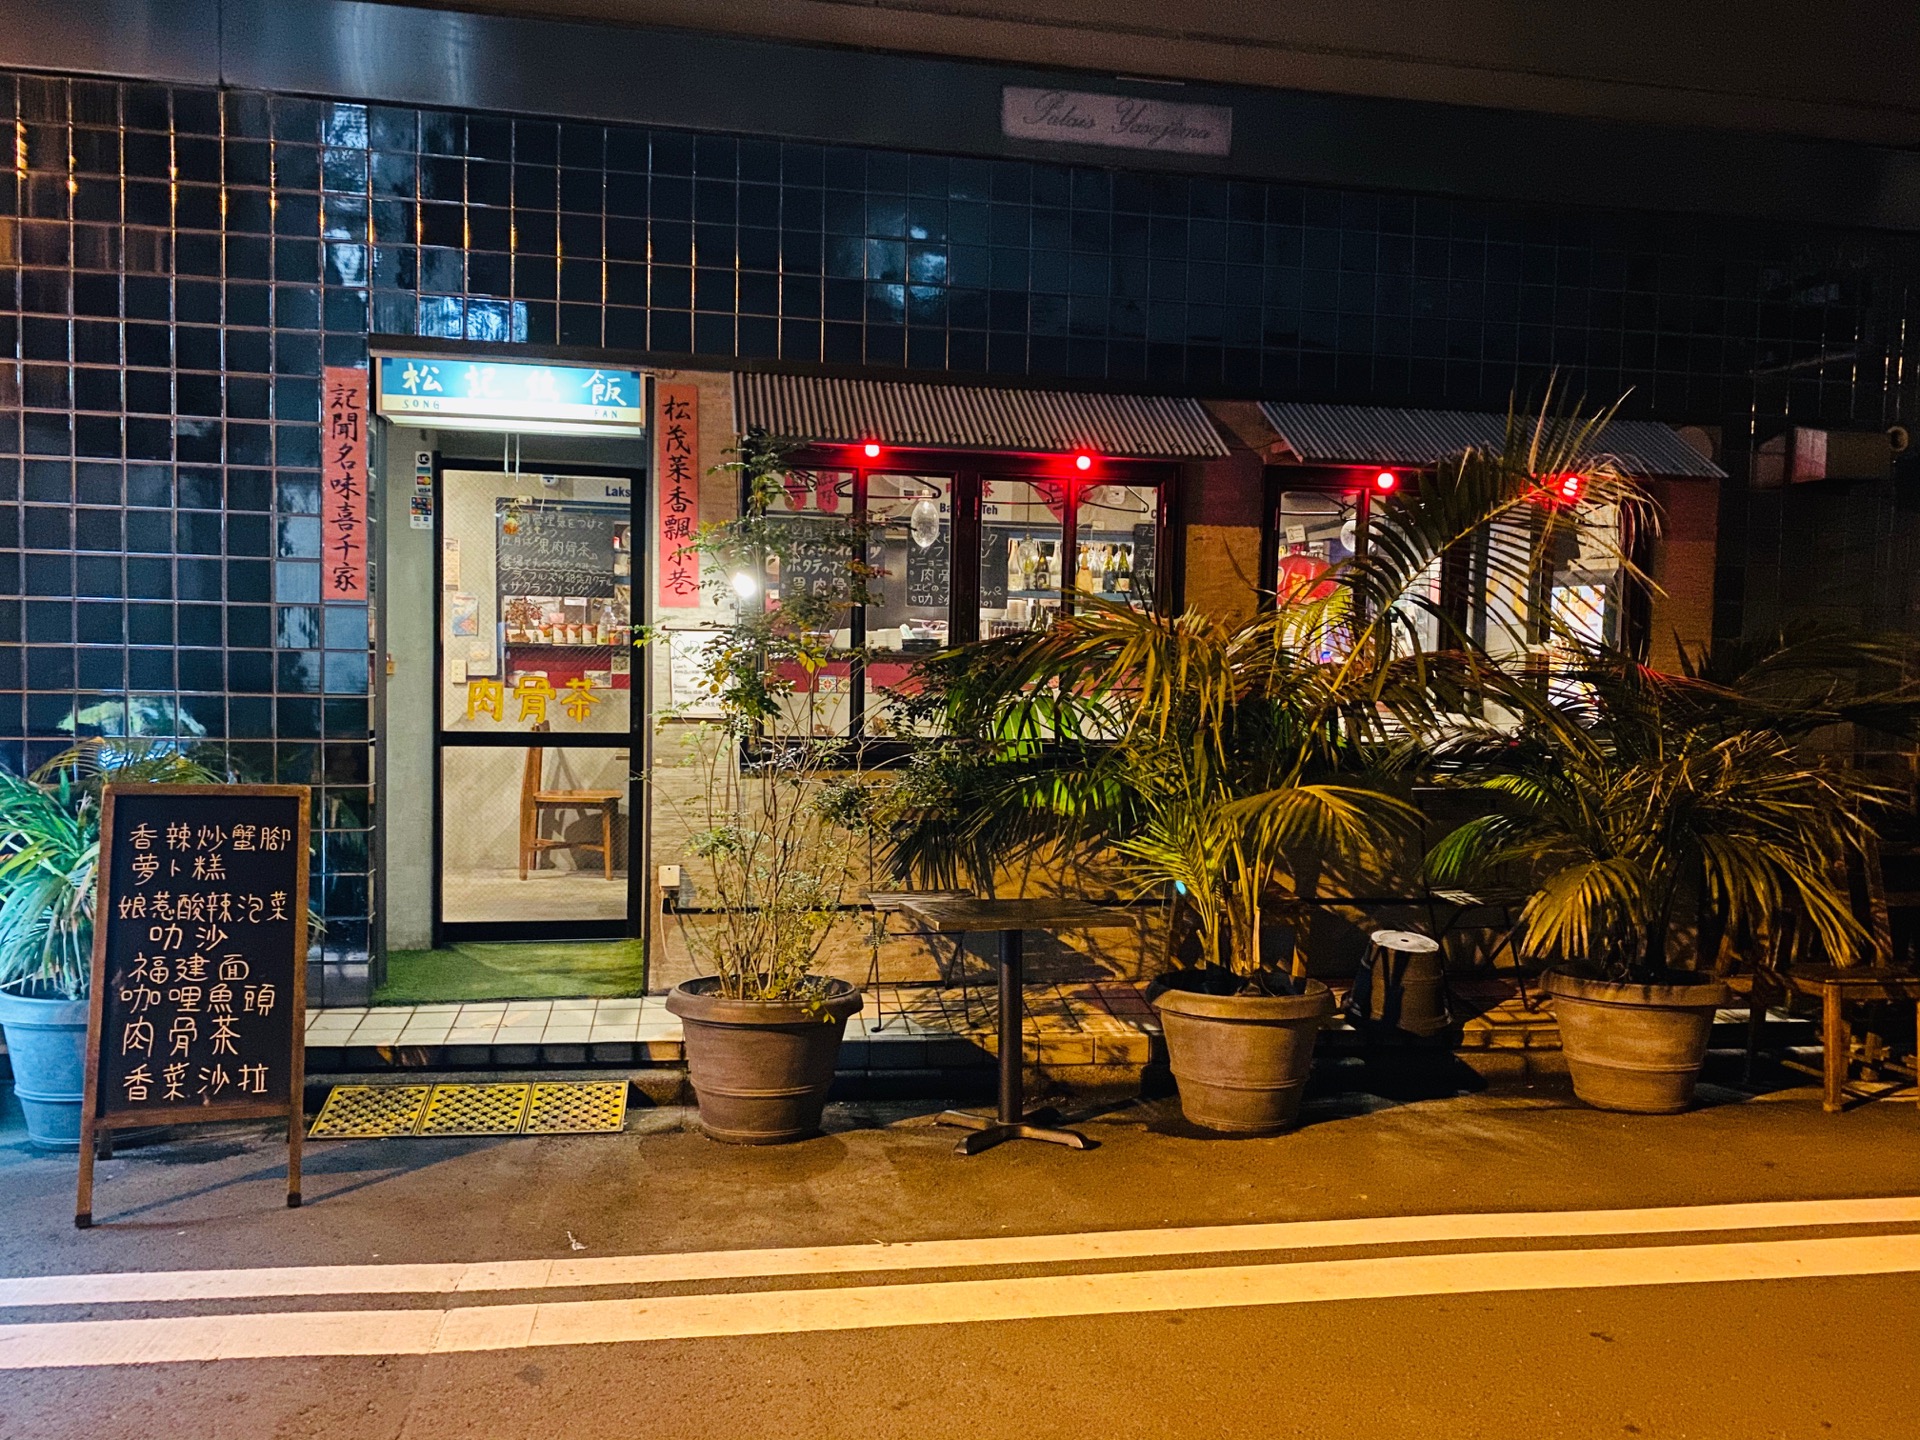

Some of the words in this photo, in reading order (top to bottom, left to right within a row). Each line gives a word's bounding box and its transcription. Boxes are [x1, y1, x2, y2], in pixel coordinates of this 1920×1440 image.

[1023, 91, 1096, 130] Palais
[402, 398, 440, 411] SONG
[593, 409, 619, 419] FAN
[330, 384, 361, 592] 記聞名味喜千家
[663, 395, 693, 596] 松茂菜香飄小巷
[467, 676, 600, 723] 肉骨茶
[129, 821, 291, 852] 香辣炒蟹腳
[118, 890, 289, 923] 娘惹酸辣泡菜
[150, 923, 229, 951] 叻沙
[128, 952, 249, 984] 福建面
[121, 983, 276, 1016] 咖哩魚頭
[122, 1014, 241, 1057] 肉骨茶
[123, 1062, 270, 1101] 香菜沙拉
